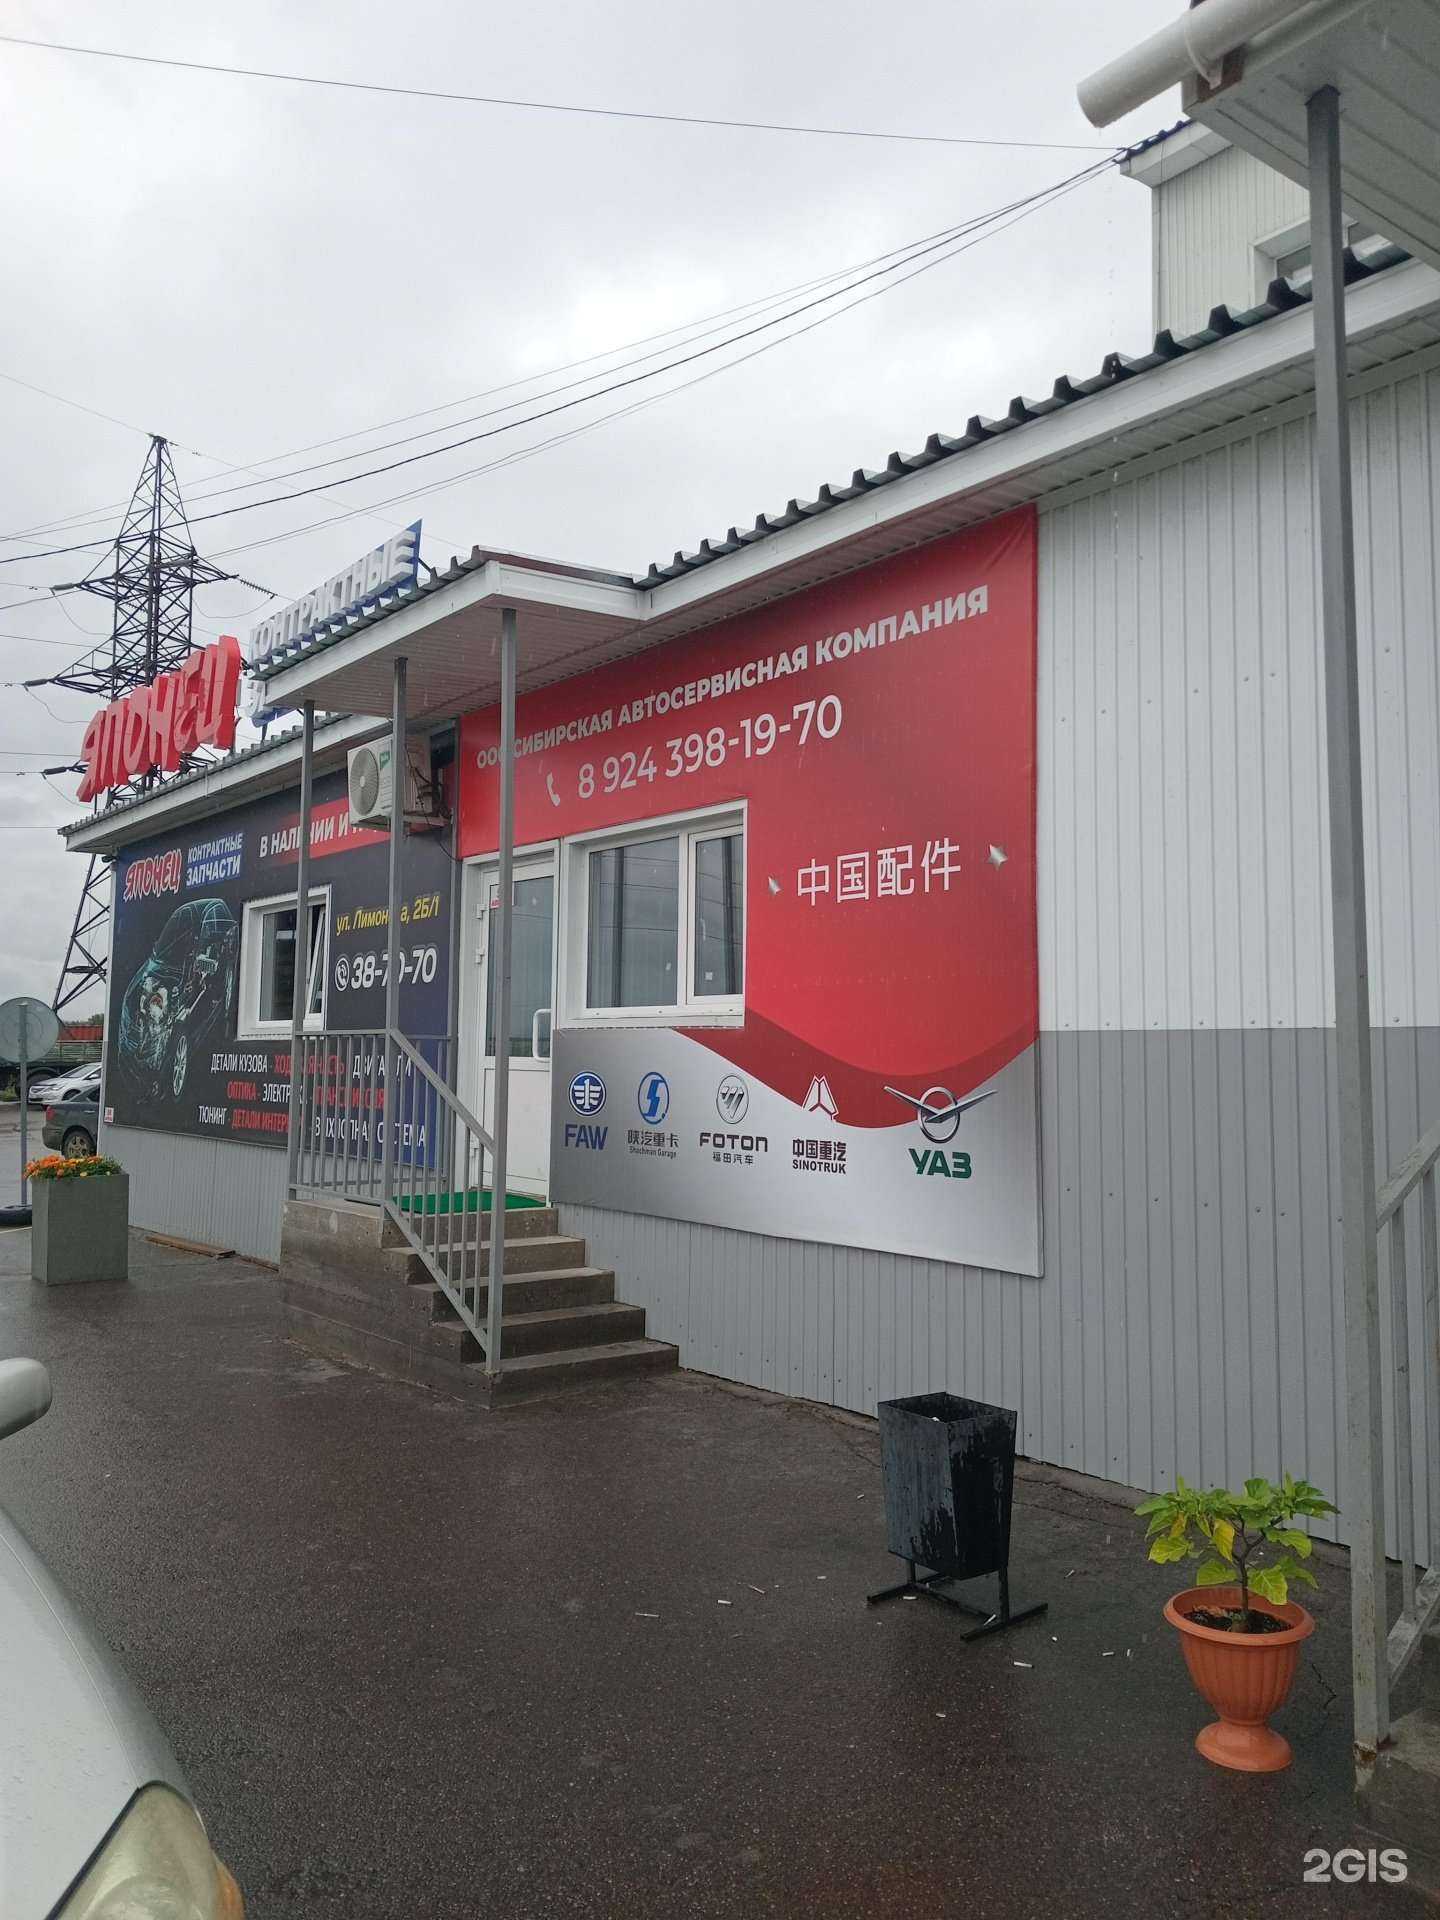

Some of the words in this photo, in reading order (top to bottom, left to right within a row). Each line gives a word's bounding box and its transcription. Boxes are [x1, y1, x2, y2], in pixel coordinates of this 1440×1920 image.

[512, 709, 612, 759] СИБИРСКАЯ
[618, 645, 808, 727] АВТОСЕРВИСНАЯ
[815, 584, 989, 666] КОМПАНИЯ
[76, 635, 242, 802] ЯПОНЕЦ
[577, 762, 596, 800] 8
[602, 746, 657, 794] 924
[665, 694, 843, 778] 398-19-70
[187, 832, 243, 866] КОНТРАКТНЫЕ
[259, 835, 269, 858] В
[338, 811, 350, 837] И
[123, 848, 183, 903] ЯПОНЕЦ
[186, 854, 241, 887] ЗАПЧАСТИ
[797, 837, 962, 907] 中国配件
[336, 915, 350, 937] ул.
[412, 895, 440, 920] 2Б/1
[211, 1053, 238, 1074] ДЕТАЛИ
[239, 1054, 268, 1073] КУЗОВА
[227, 1081, 257, 1100] ОПТИКА
[198, 1105, 227, 1125] ТЮНИНГ
[564, 1123, 608, 1151] FAW
[699, 1132, 768, 1153] FOTON
[792, 1138, 847, 1162] 中国重汽
[712, 1151, 754, 1166] 福田汽车
[792, 1159, 847, 1175] SINOTRUK
[908, 1148, 972, 1179] УАЗ
